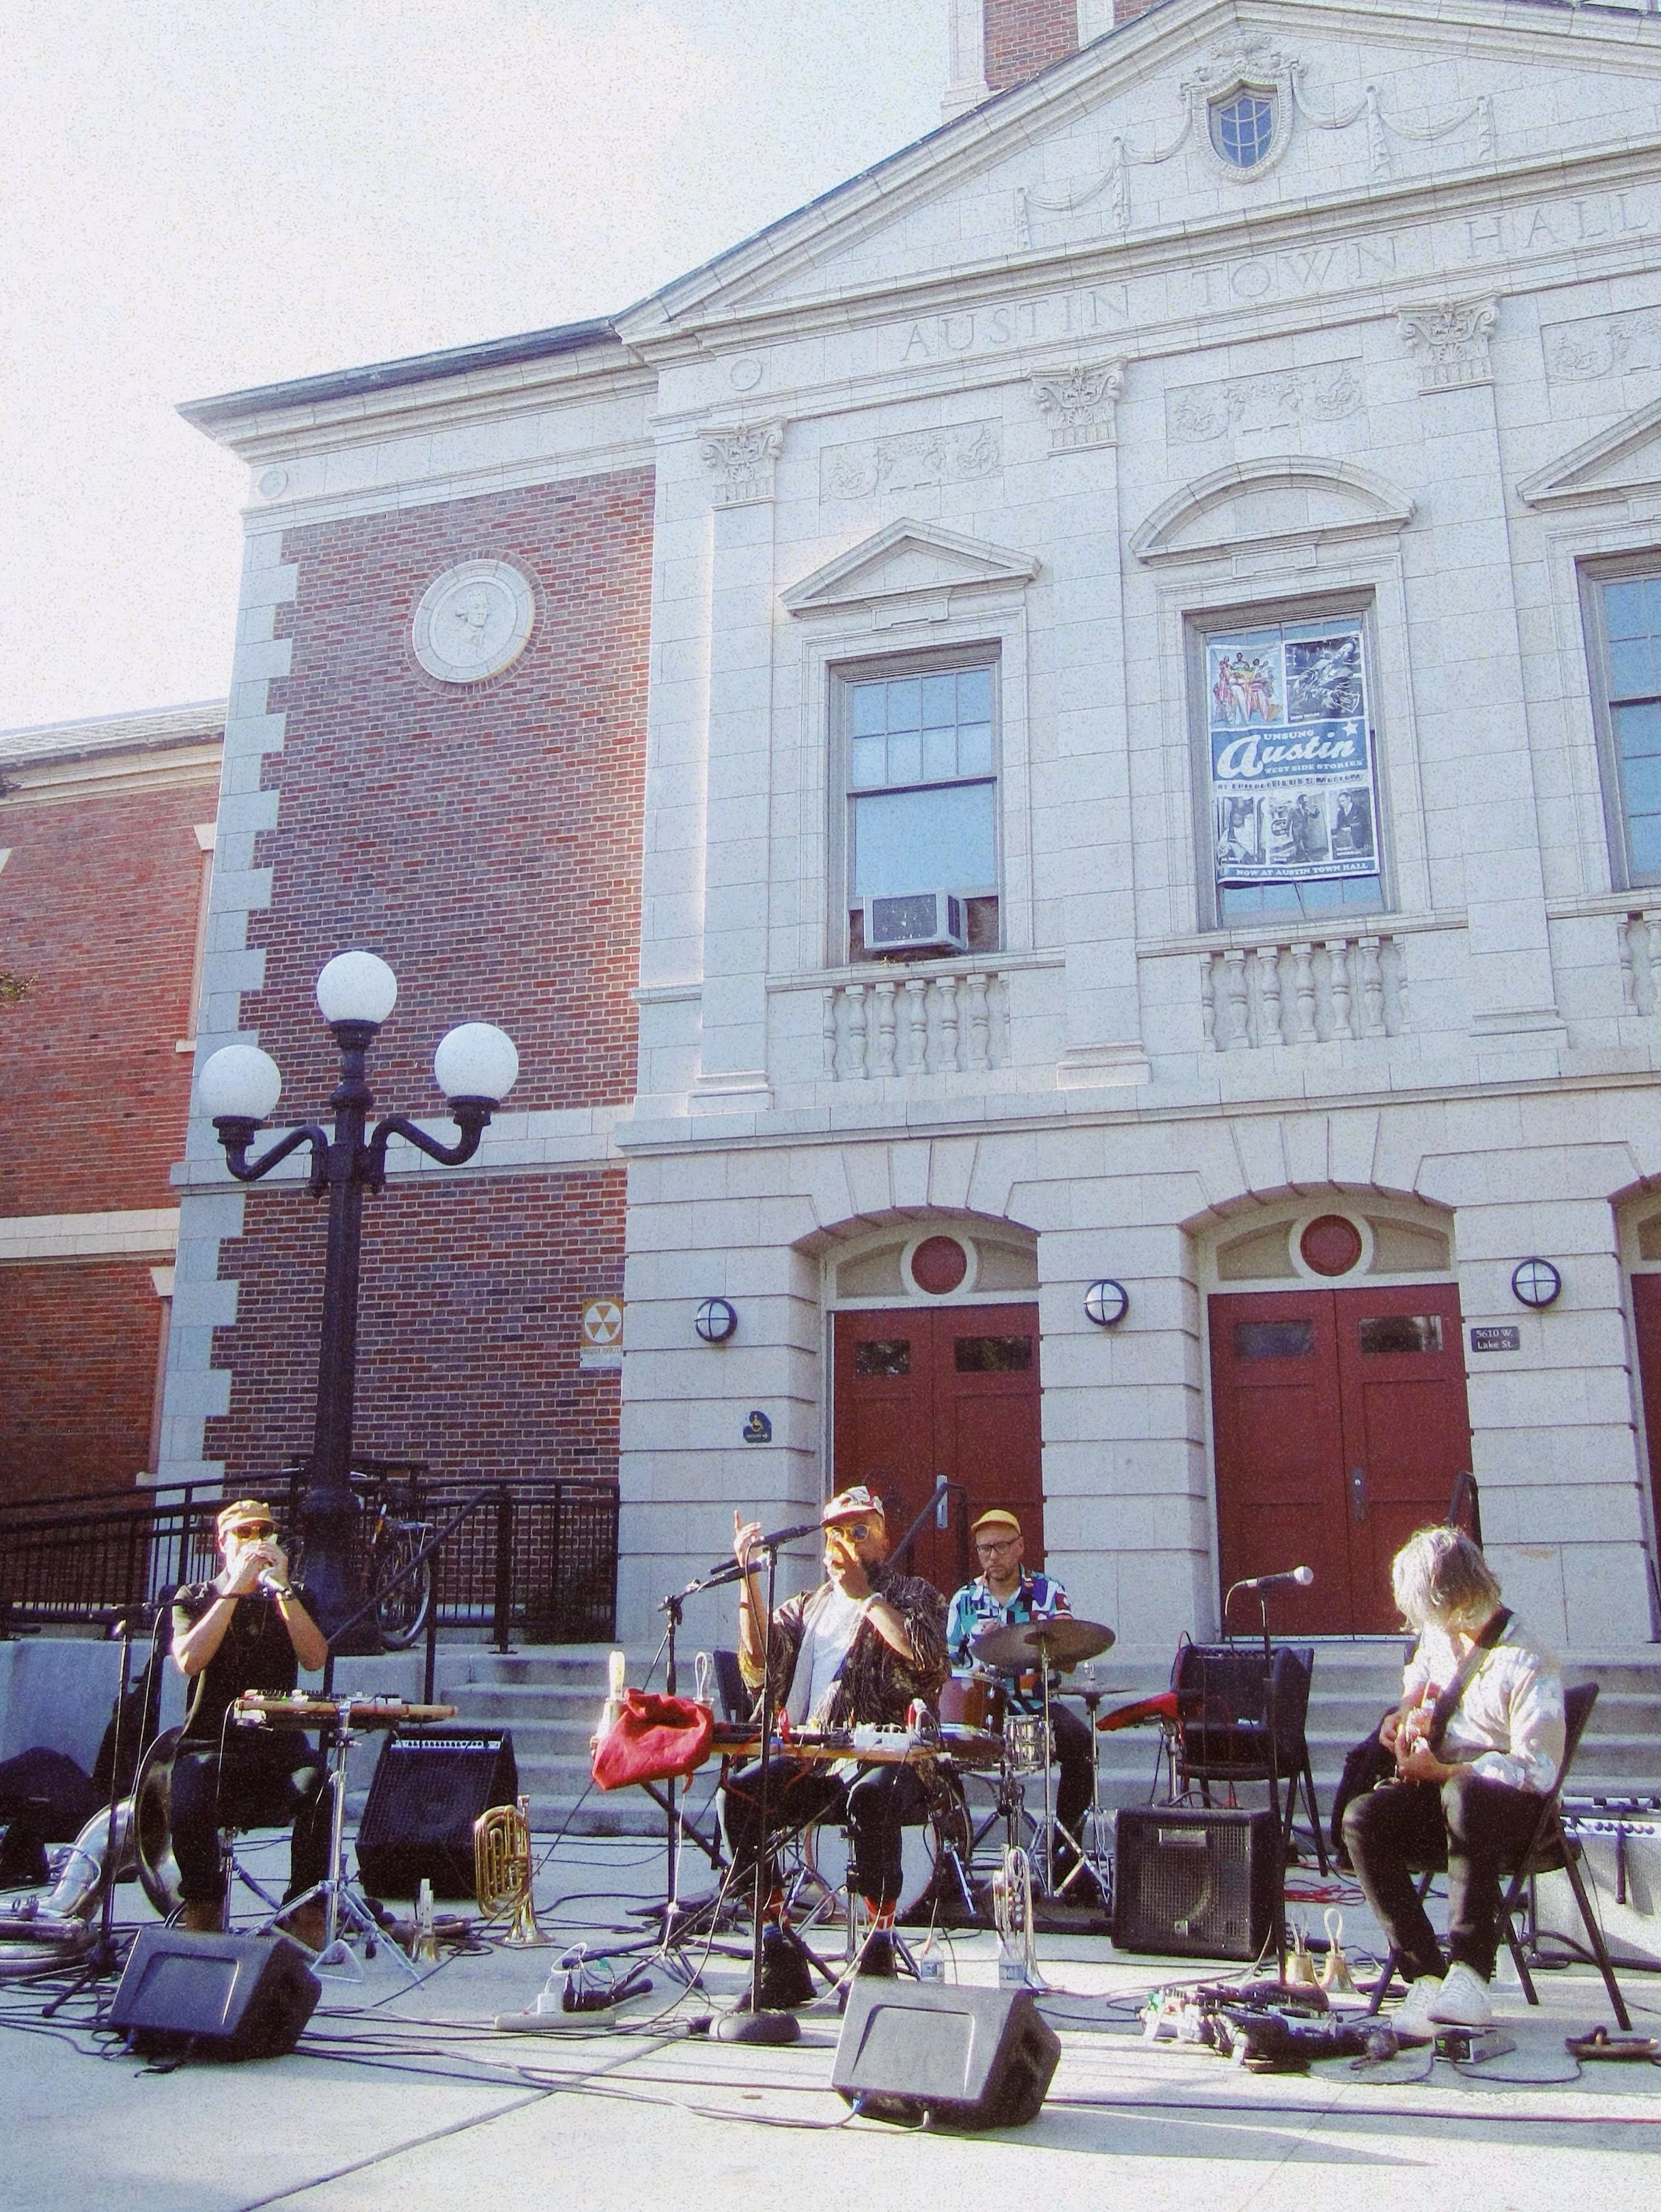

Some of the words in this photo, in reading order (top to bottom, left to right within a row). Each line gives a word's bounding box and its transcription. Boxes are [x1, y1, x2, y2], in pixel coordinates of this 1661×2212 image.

[899, 284, 1132, 361] AUSTIN
[1191, 236, 1399, 306] TOWN
[1464, 193, 1650, 260] HALL
[1264, 729, 1315, 741] UNSUNG
[1216, 731, 1356, 779] Austin
[1264, 765, 1290, 774] WEST
[1291, 764, 1315, 772] SIDE
[1316, 760, 1363, 770] STORIES
[1311, 865, 1341, 873] TOWN
[1343, 863, 1369, 871] HALL
[1476, 1329, 1499, 1339] 5610
[1501, 1328, 1513, 1337] W.
[1477, 1341, 1499, 1349] Lake
[1501, 1340, 1514, 1348] St.
